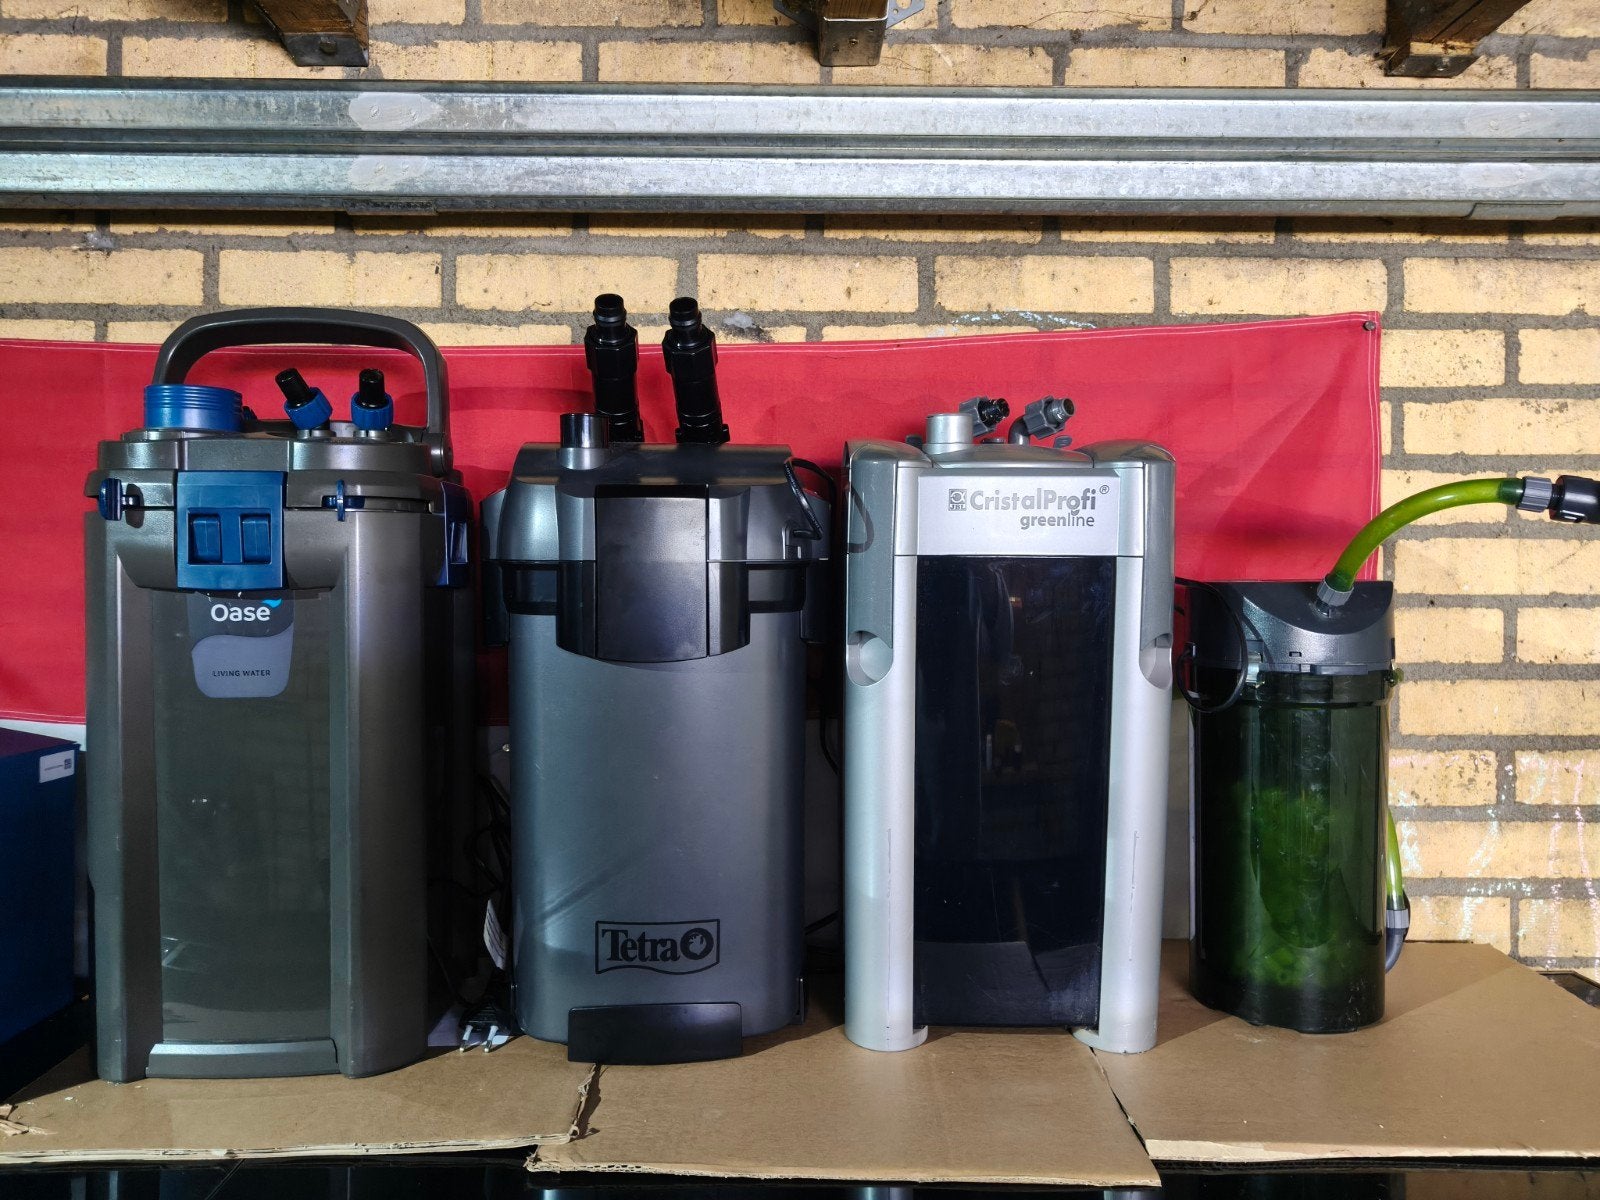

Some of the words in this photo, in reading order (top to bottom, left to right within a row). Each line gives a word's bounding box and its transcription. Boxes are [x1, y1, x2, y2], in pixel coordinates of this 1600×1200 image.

[1020, 512, 1095, 530] greenline
[210, 603, 271, 622] Oase
[212, 669, 240, 677] LIVING
[242, 669, 271, 677] WATER
[601, 928, 681, 962] Tetra
